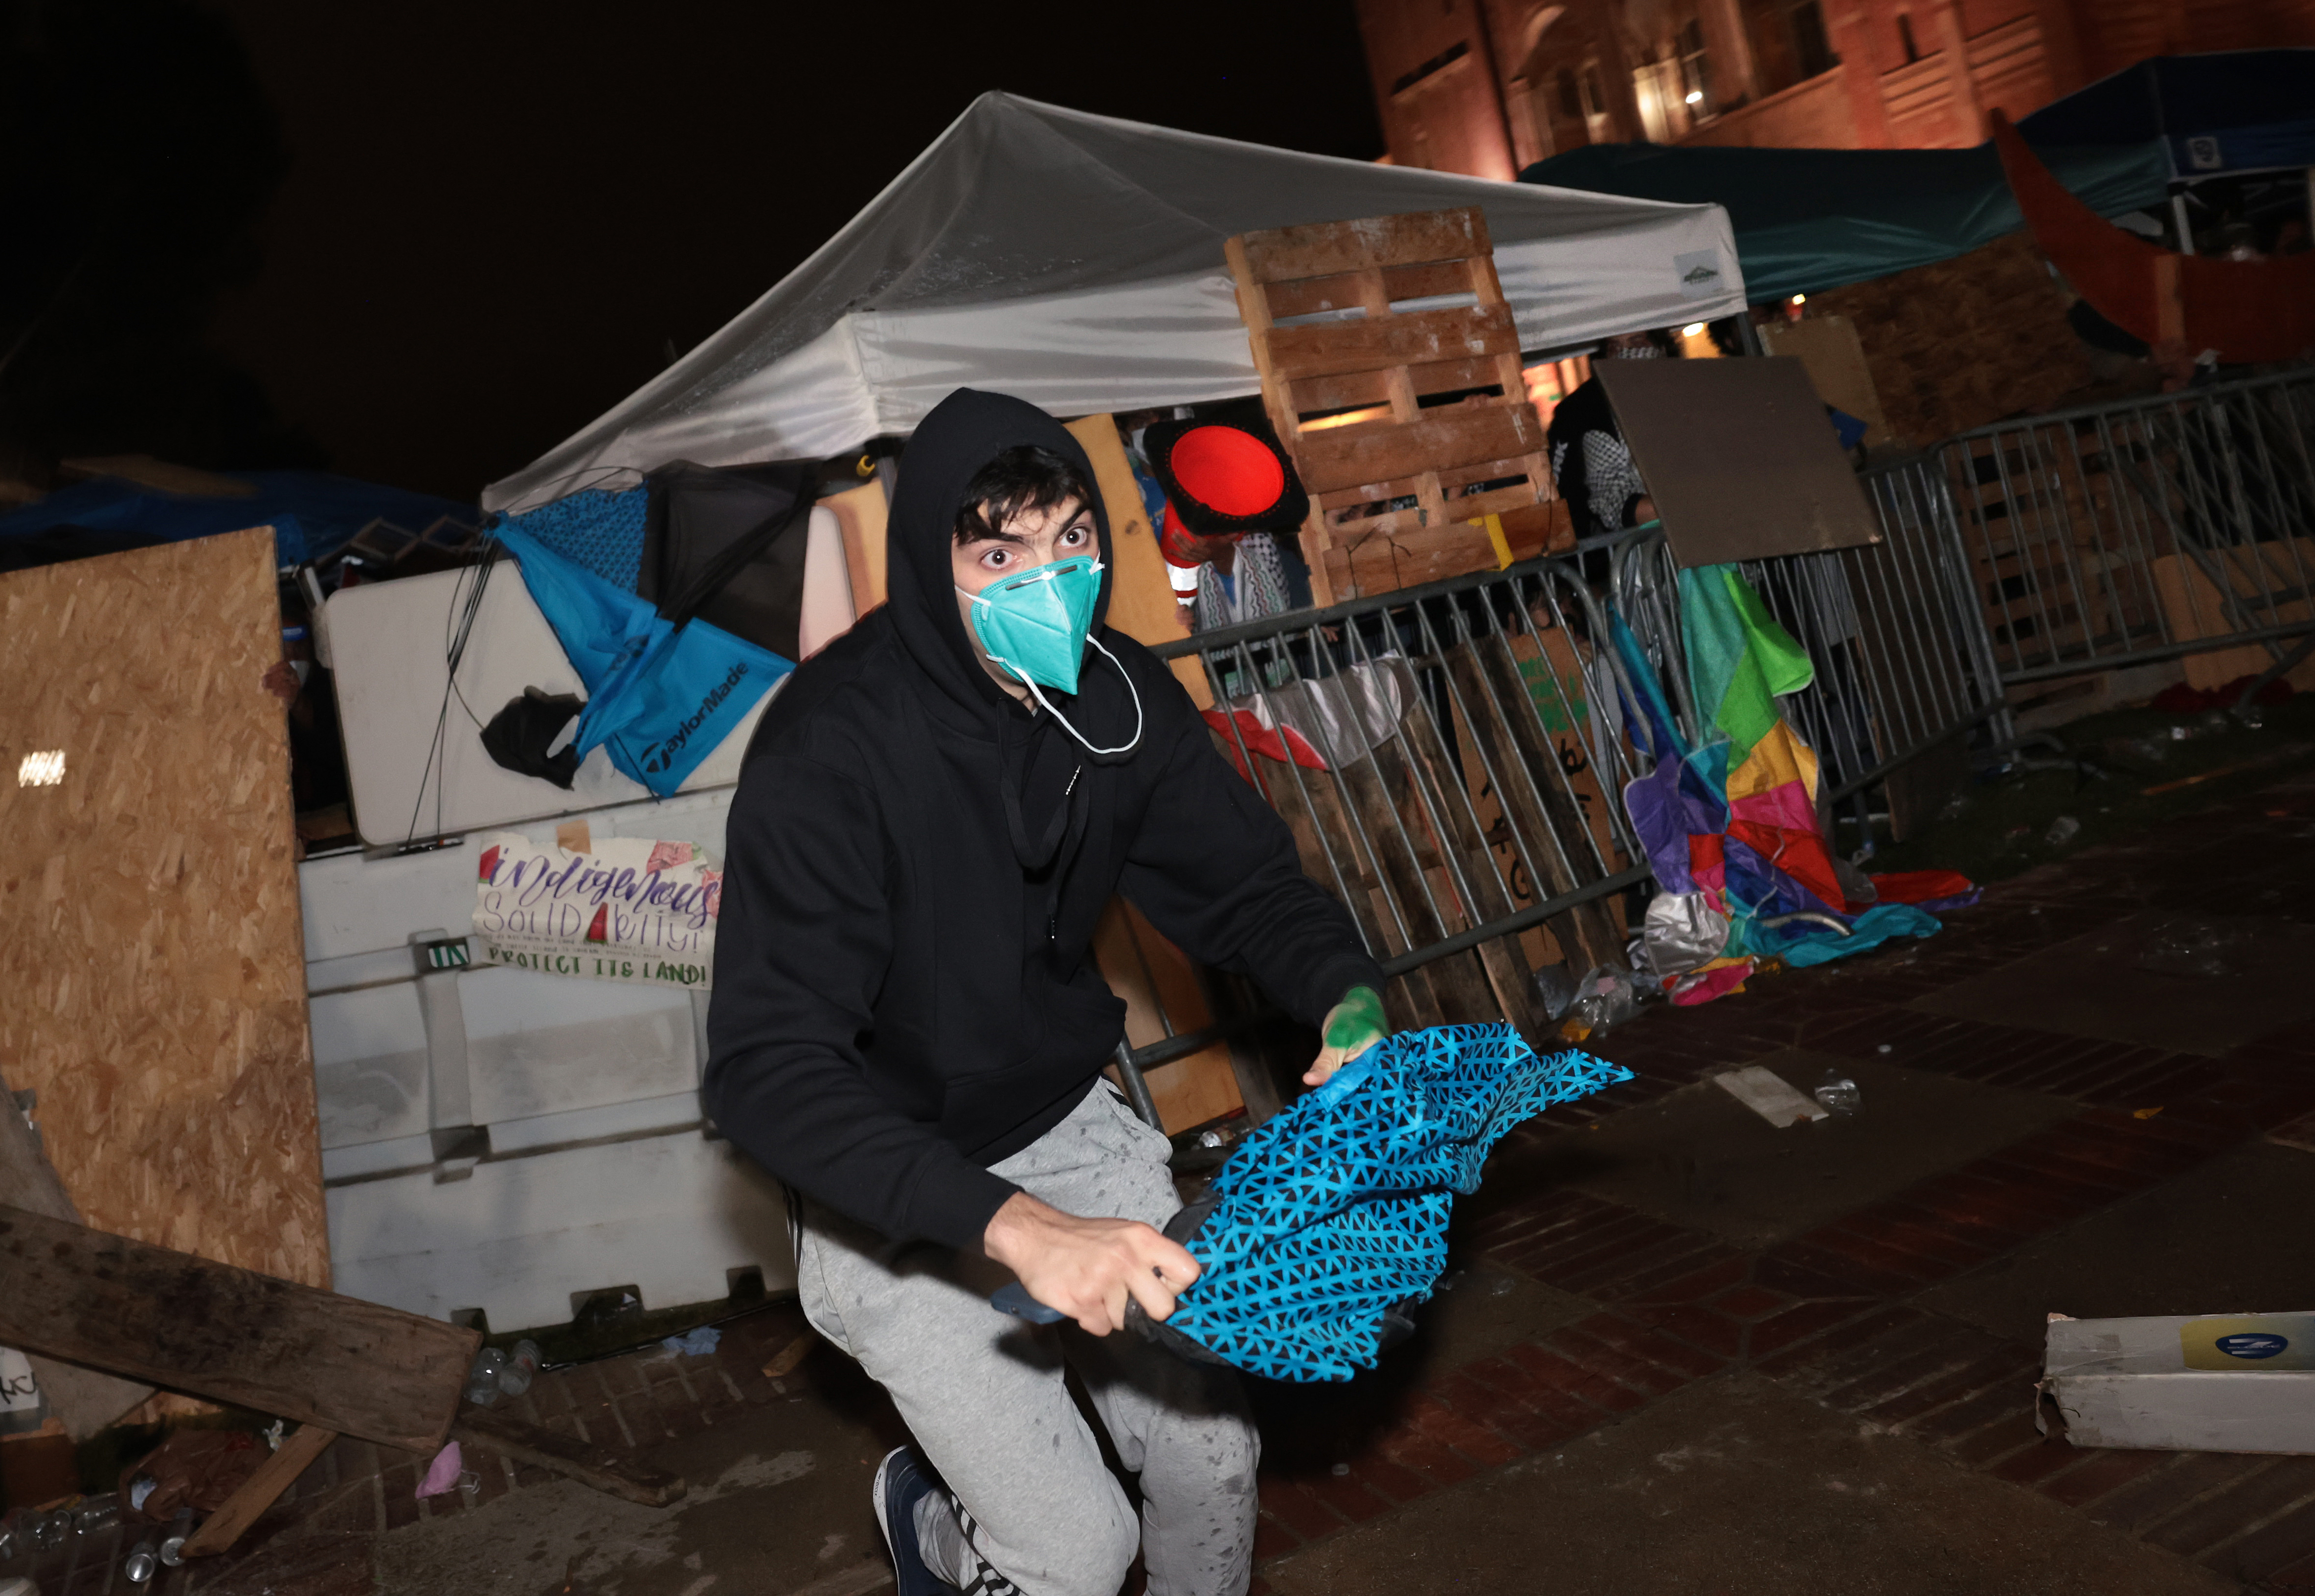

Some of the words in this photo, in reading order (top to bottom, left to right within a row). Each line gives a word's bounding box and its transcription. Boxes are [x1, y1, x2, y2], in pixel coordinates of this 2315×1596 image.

[640, 660, 749, 773] TaylorMade
[593, 958, 634, 977] ITS
[643, 960, 706, 987] LAND!
